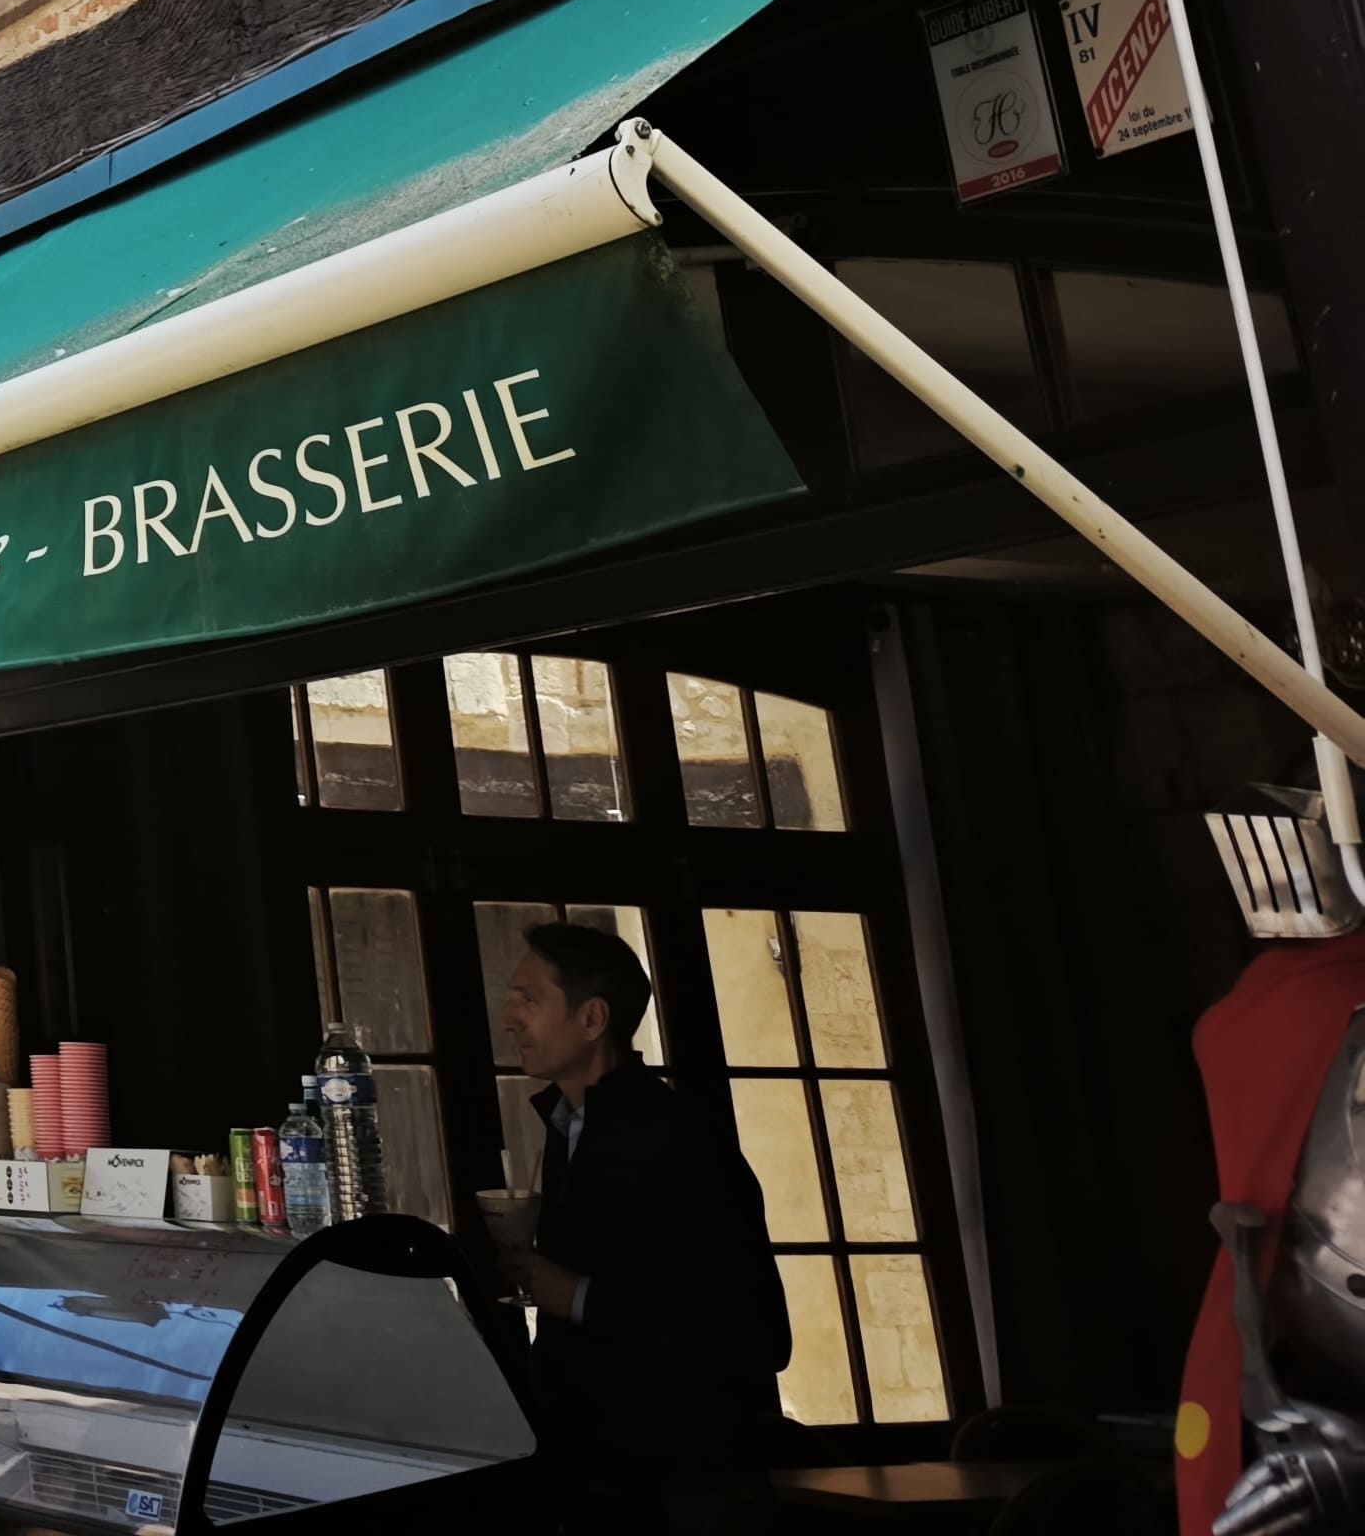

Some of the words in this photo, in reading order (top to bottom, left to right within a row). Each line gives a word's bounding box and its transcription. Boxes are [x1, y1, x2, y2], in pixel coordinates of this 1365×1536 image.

[929, 11, 968, 44] GUIDE
[1067, 1, 1102, 45] IV
[1078, 48, 1096, 64] 81
[1118, 129, 1130, 143] 24
[1132, 112, 1183, 138] septembre
[1129, 110, 1141, 123] loi
[1142, 106, 1155, 118] du
[990, 167, 1027, 189] 2016
[82, 369, 576, 577] BRASSERIE
